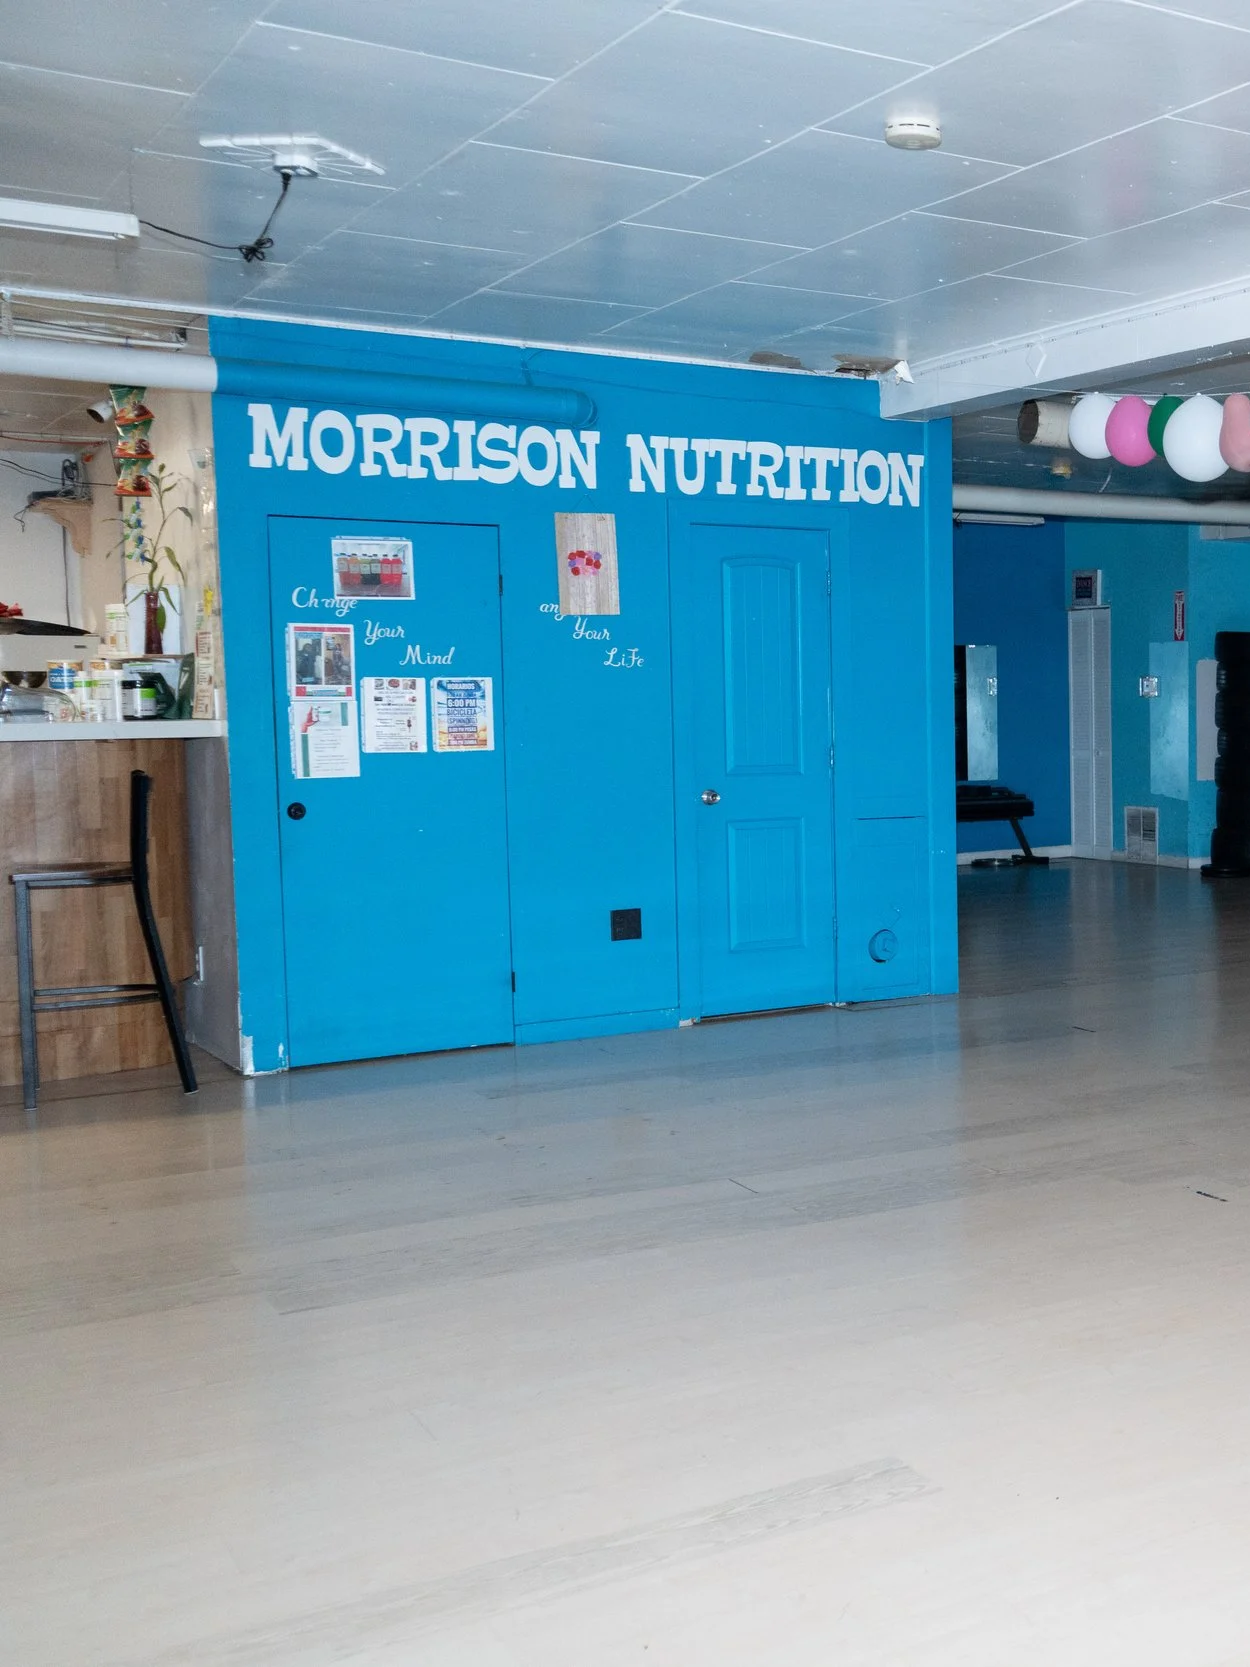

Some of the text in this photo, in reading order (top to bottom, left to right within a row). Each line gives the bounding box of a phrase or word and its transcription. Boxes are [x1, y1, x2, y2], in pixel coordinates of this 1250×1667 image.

[247, 404, 925, 507] MORRISON NUTRITION
[363, 620, 405, 645] Your
[573, 616, 612, 640] Your
[399, 645, 456, 665] Mind
[465, 699, 476, 707] PM
